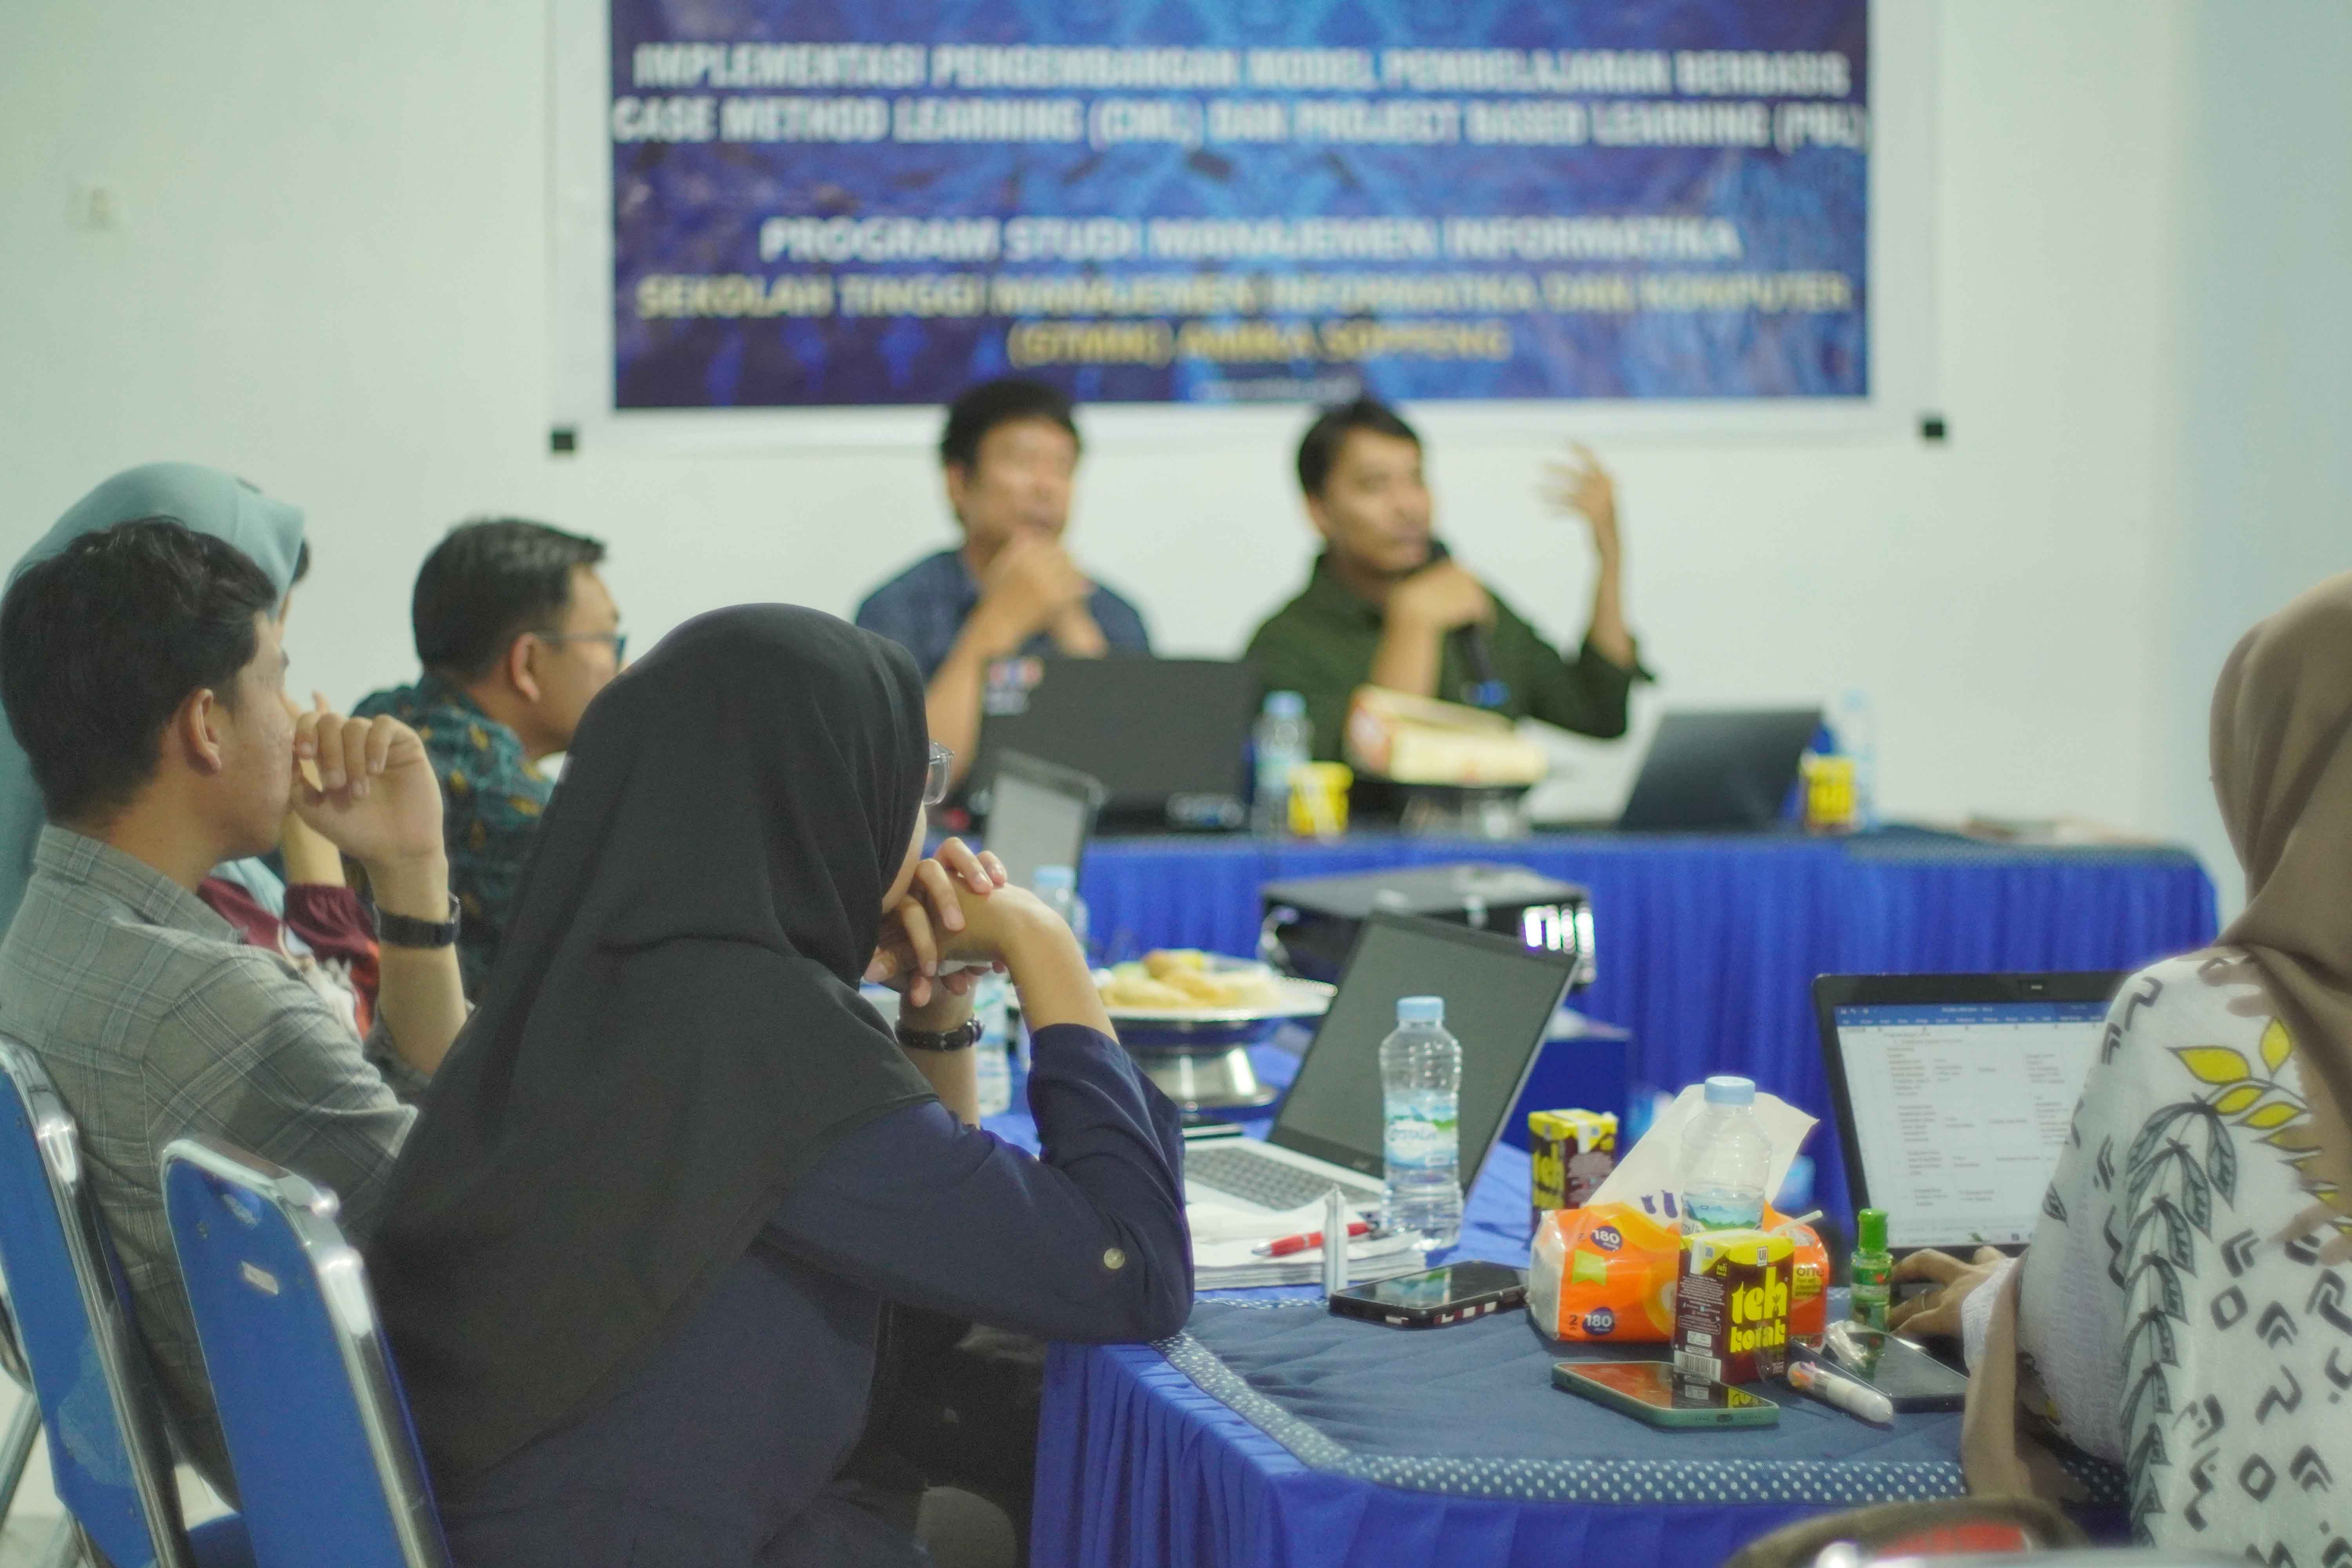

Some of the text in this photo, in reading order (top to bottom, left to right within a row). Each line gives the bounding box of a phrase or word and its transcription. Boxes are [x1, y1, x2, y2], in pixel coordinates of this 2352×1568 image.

[633, 43, 924, 88] IMPLEMENTASI
[1250, 49, 1372, 91] MODEL
[613, 98, 716, 142] CASE
[720, 98, 889, 142] METHOD
[893, 99, 1083, 143] LEARNING
[1295, 102, 1459, 144] PROJECT
[1592, 104, 1769, 147] LEARNING
[759, 216, 1742, 263] PROGRAM STUDI MANAJEMEN INFORMATIKA
[635, 273, 834, 319] SEKOLAH
[840, 273, 980, 318] TINGGI
[1592, 1229, 1620, 1244] 180
[1797, 1267, 1825, 1277] one
[1731, 1267, 1788, 1324] teh
[1569, 1314, 1578, 1325] 2
[1585, 1314, 1612, 1327] 180
[1730, 1319, 1786, 1353] kotak
